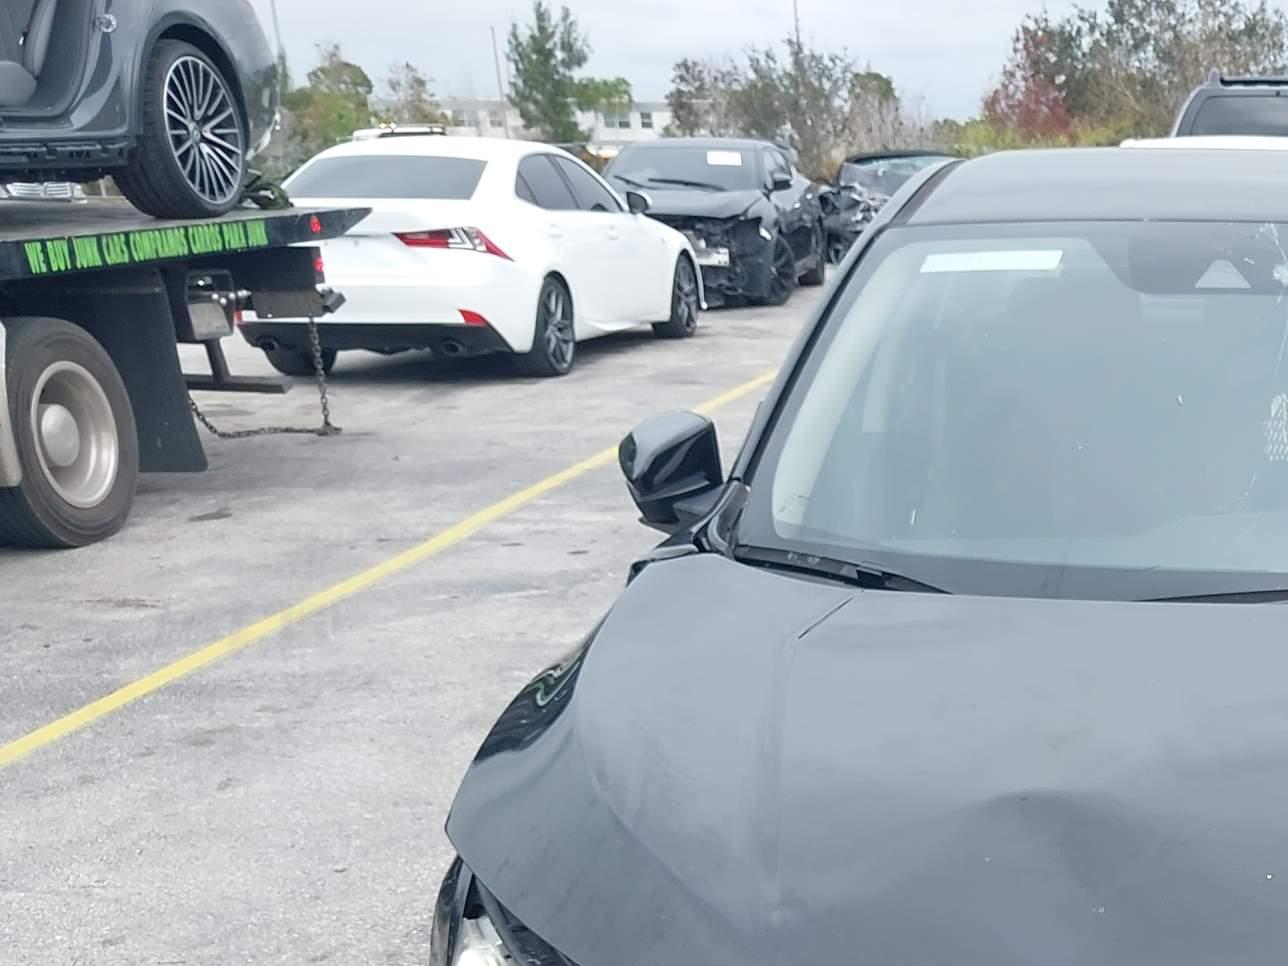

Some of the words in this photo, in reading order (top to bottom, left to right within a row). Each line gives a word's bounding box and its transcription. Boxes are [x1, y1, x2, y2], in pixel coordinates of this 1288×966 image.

[25, 240, 47, 274] WE
[46, 239, 72, 272] BUY
[72, 236, 103, 269] JUNK
[101, 232, 129, 266] CARS
